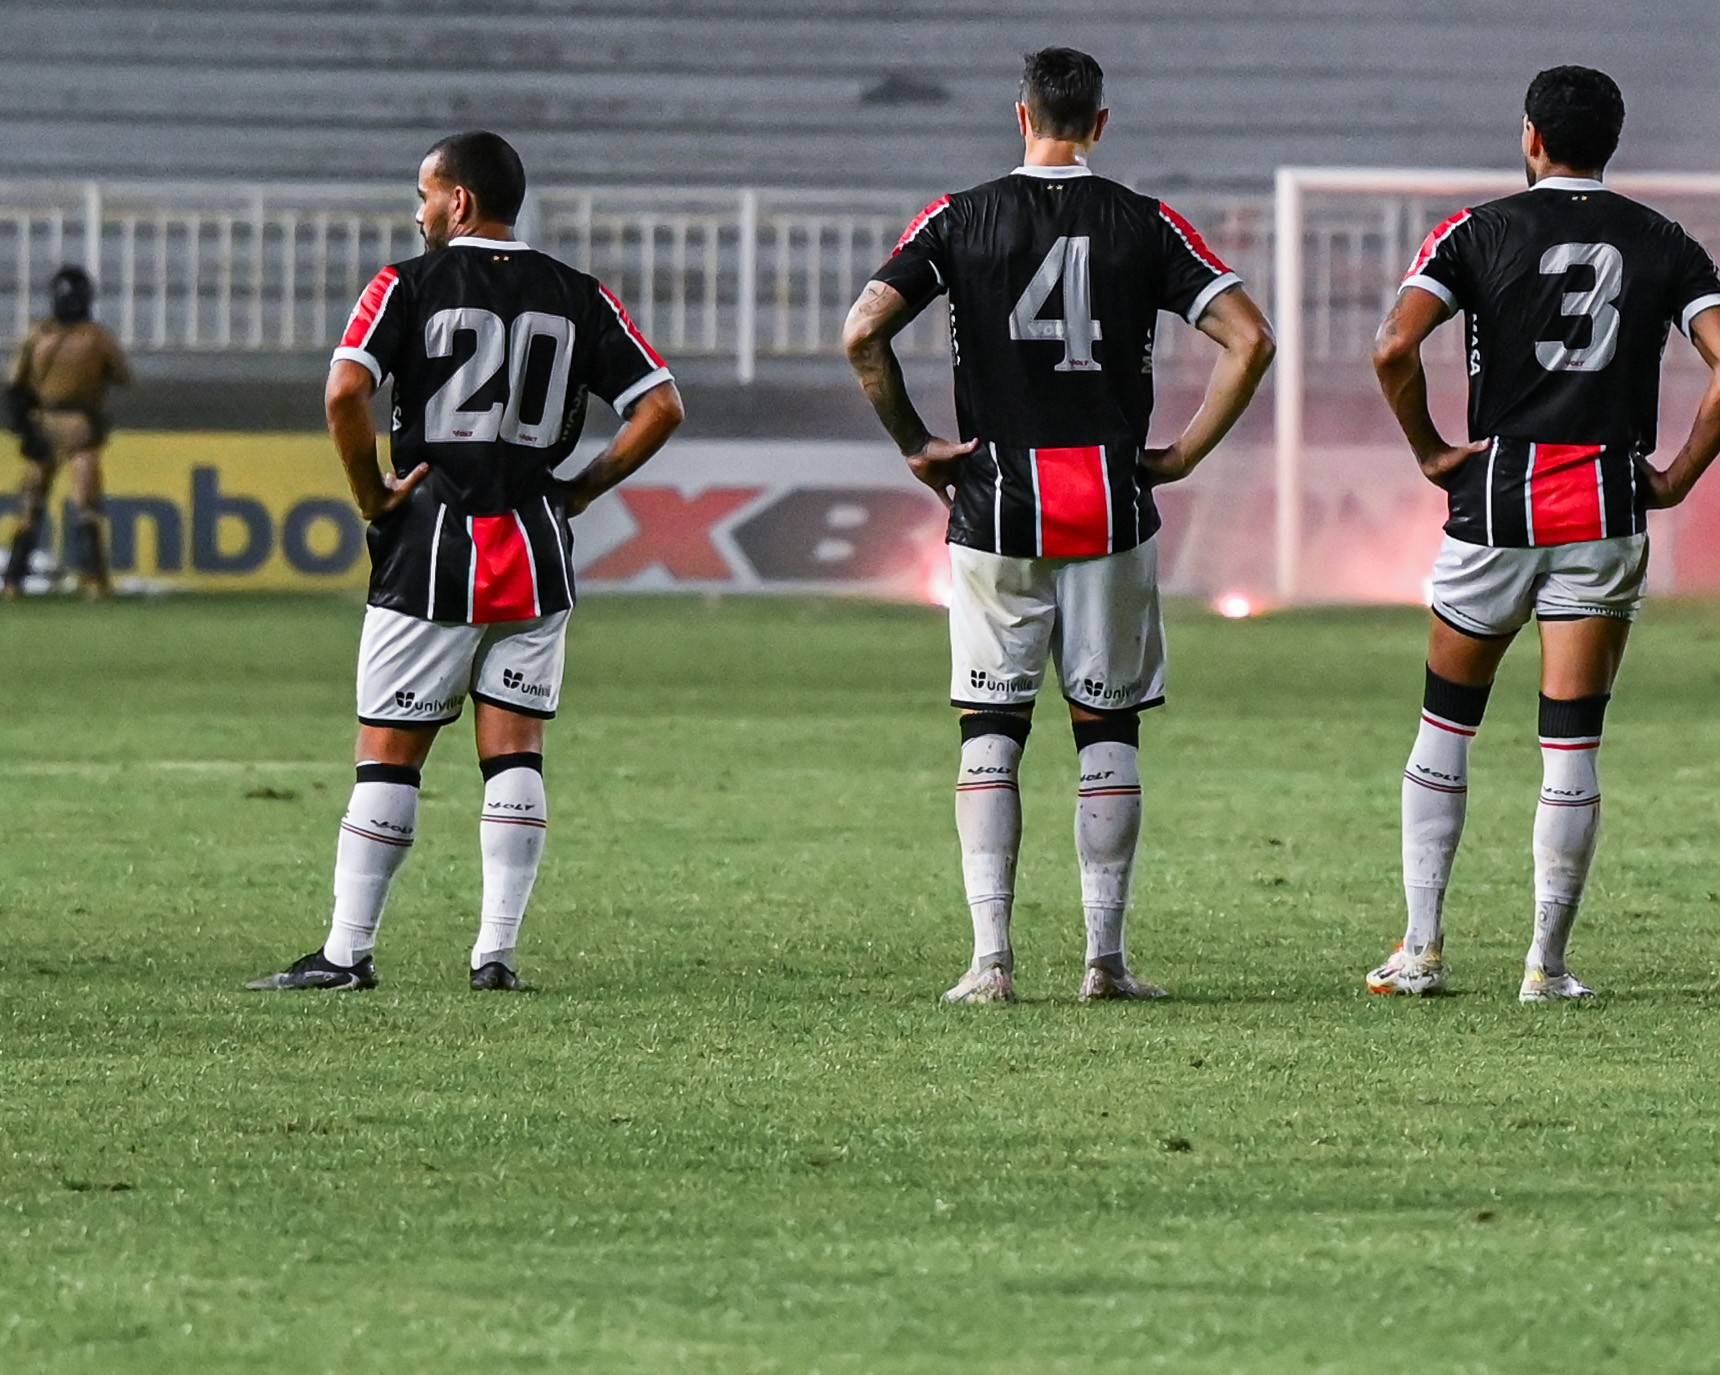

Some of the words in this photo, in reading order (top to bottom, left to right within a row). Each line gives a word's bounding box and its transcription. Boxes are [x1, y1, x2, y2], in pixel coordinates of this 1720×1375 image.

[1008, 236, 1103, 371] 4
[1535, 242, 1623, 372] 3
[424, 307, 576, 449] 20
[0, 461, 365, 573] mbo
